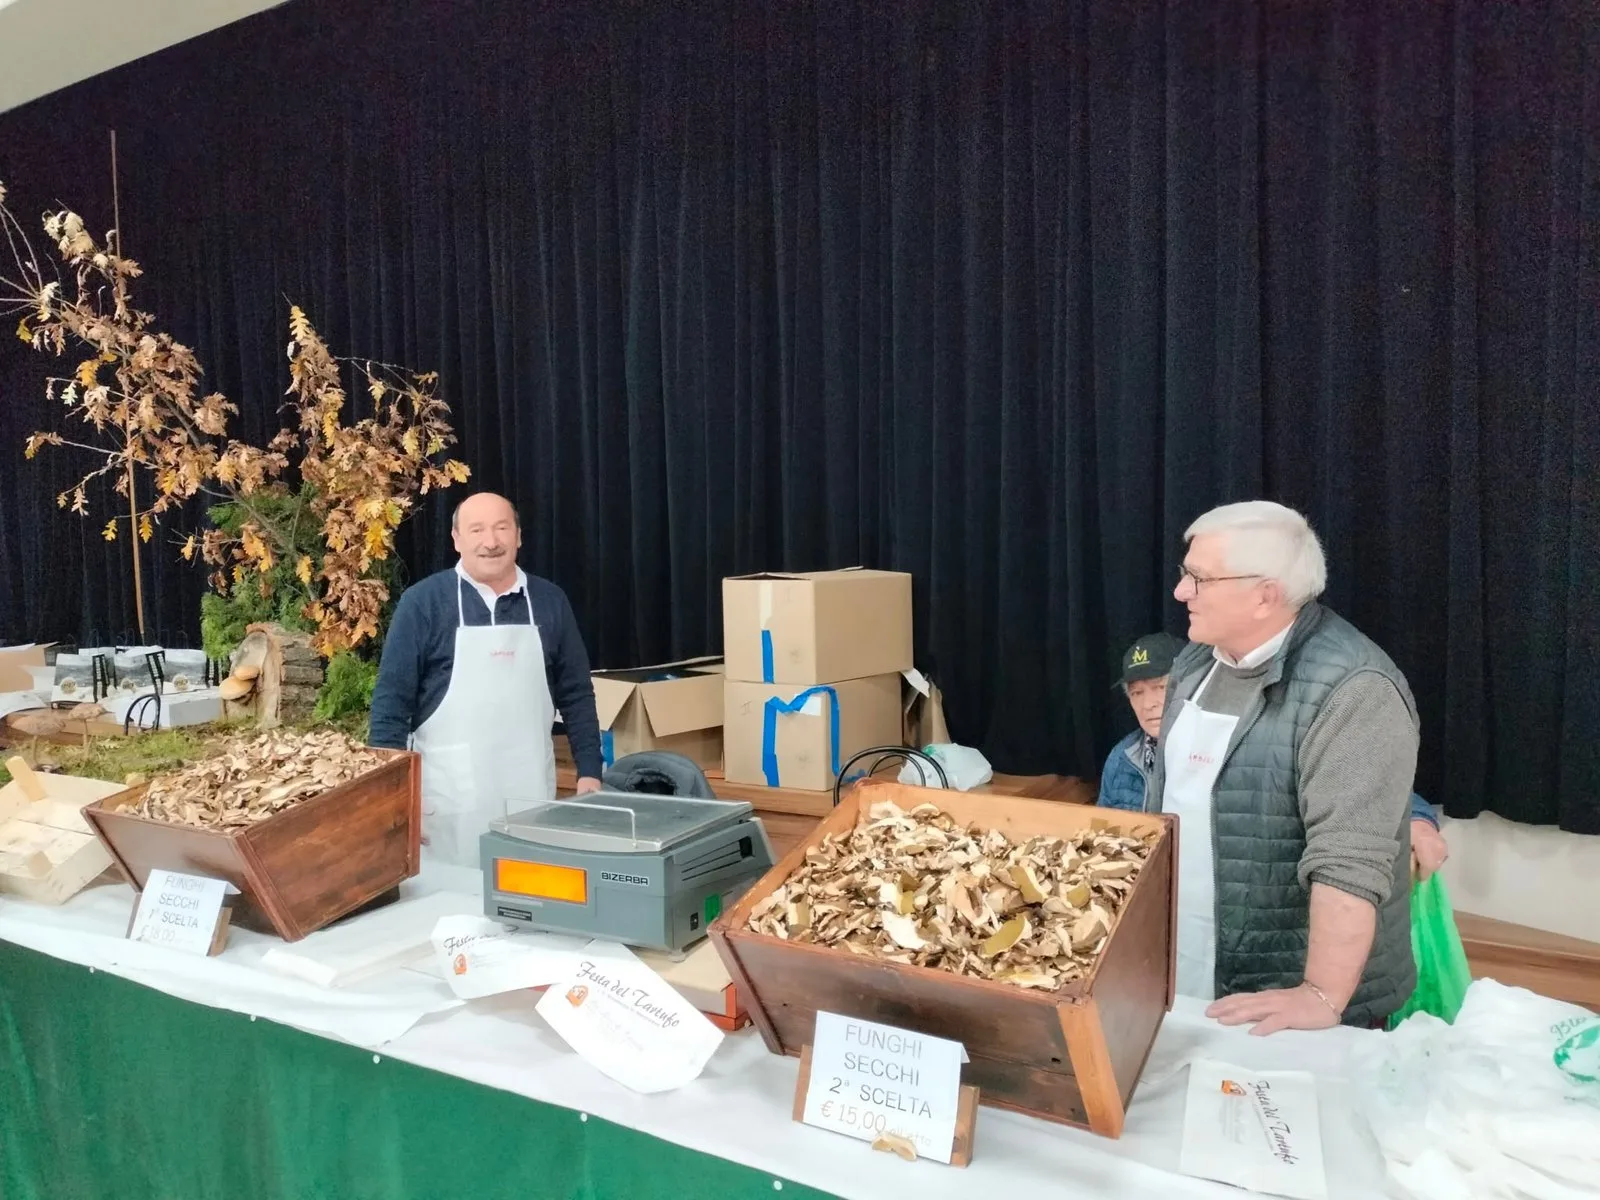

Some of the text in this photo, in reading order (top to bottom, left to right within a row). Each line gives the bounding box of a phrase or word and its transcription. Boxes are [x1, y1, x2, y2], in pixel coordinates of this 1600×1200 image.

[164, 875, 205, 893] FUNGHI
[601, 872, 649, 886] BIZERBA
[158, 892, 200, 911] SECCHI
[161, 911, 199, 929] SCELTA
[576, 961, 611, 988] Festa
[610, 979, 631, 998] del
[632, 989, 681, 1029] Tartufo
[845, 1023, 923, 1060] FUNGHI
[843, 1051, 920, 1087] SECCHI
[820, 1100, 835, 1118] €
[838, 1103, 887, 1134] 15,00
[859, 1084, 933, 1119] SCELTA
